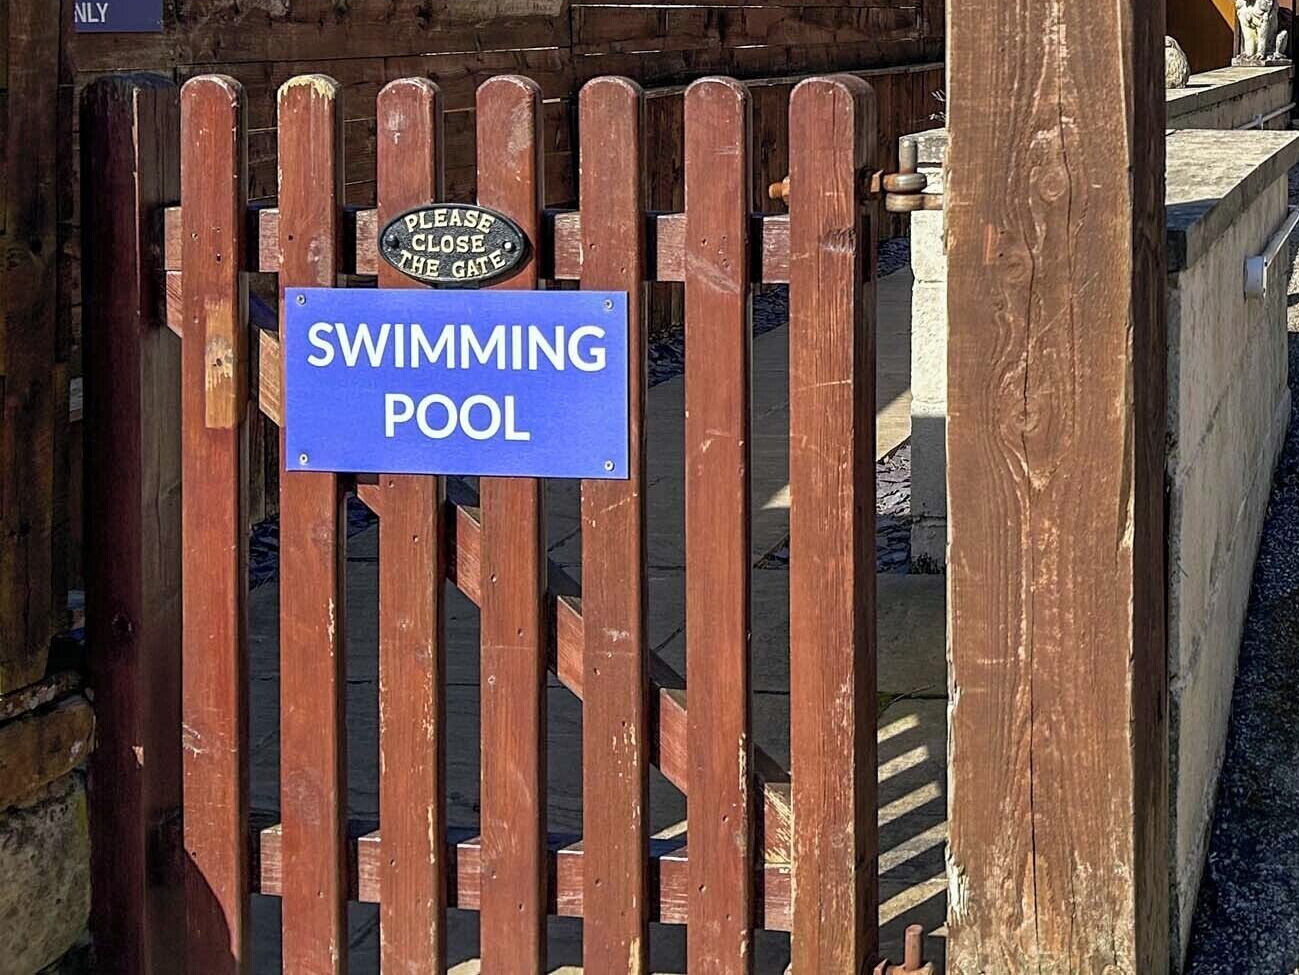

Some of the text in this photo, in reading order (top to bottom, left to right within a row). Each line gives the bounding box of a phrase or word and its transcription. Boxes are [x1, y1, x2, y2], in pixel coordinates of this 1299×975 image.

[74, 2, 108, 23] NLY
[404, 208, 495, 234] PLEASE
[412, 234, 485, 253] CLOSE
[398, 249, 506, 278] THE GATE
[307, 322, 606, 371] SWIMMING
[384, 393, 531, 441] POOL
